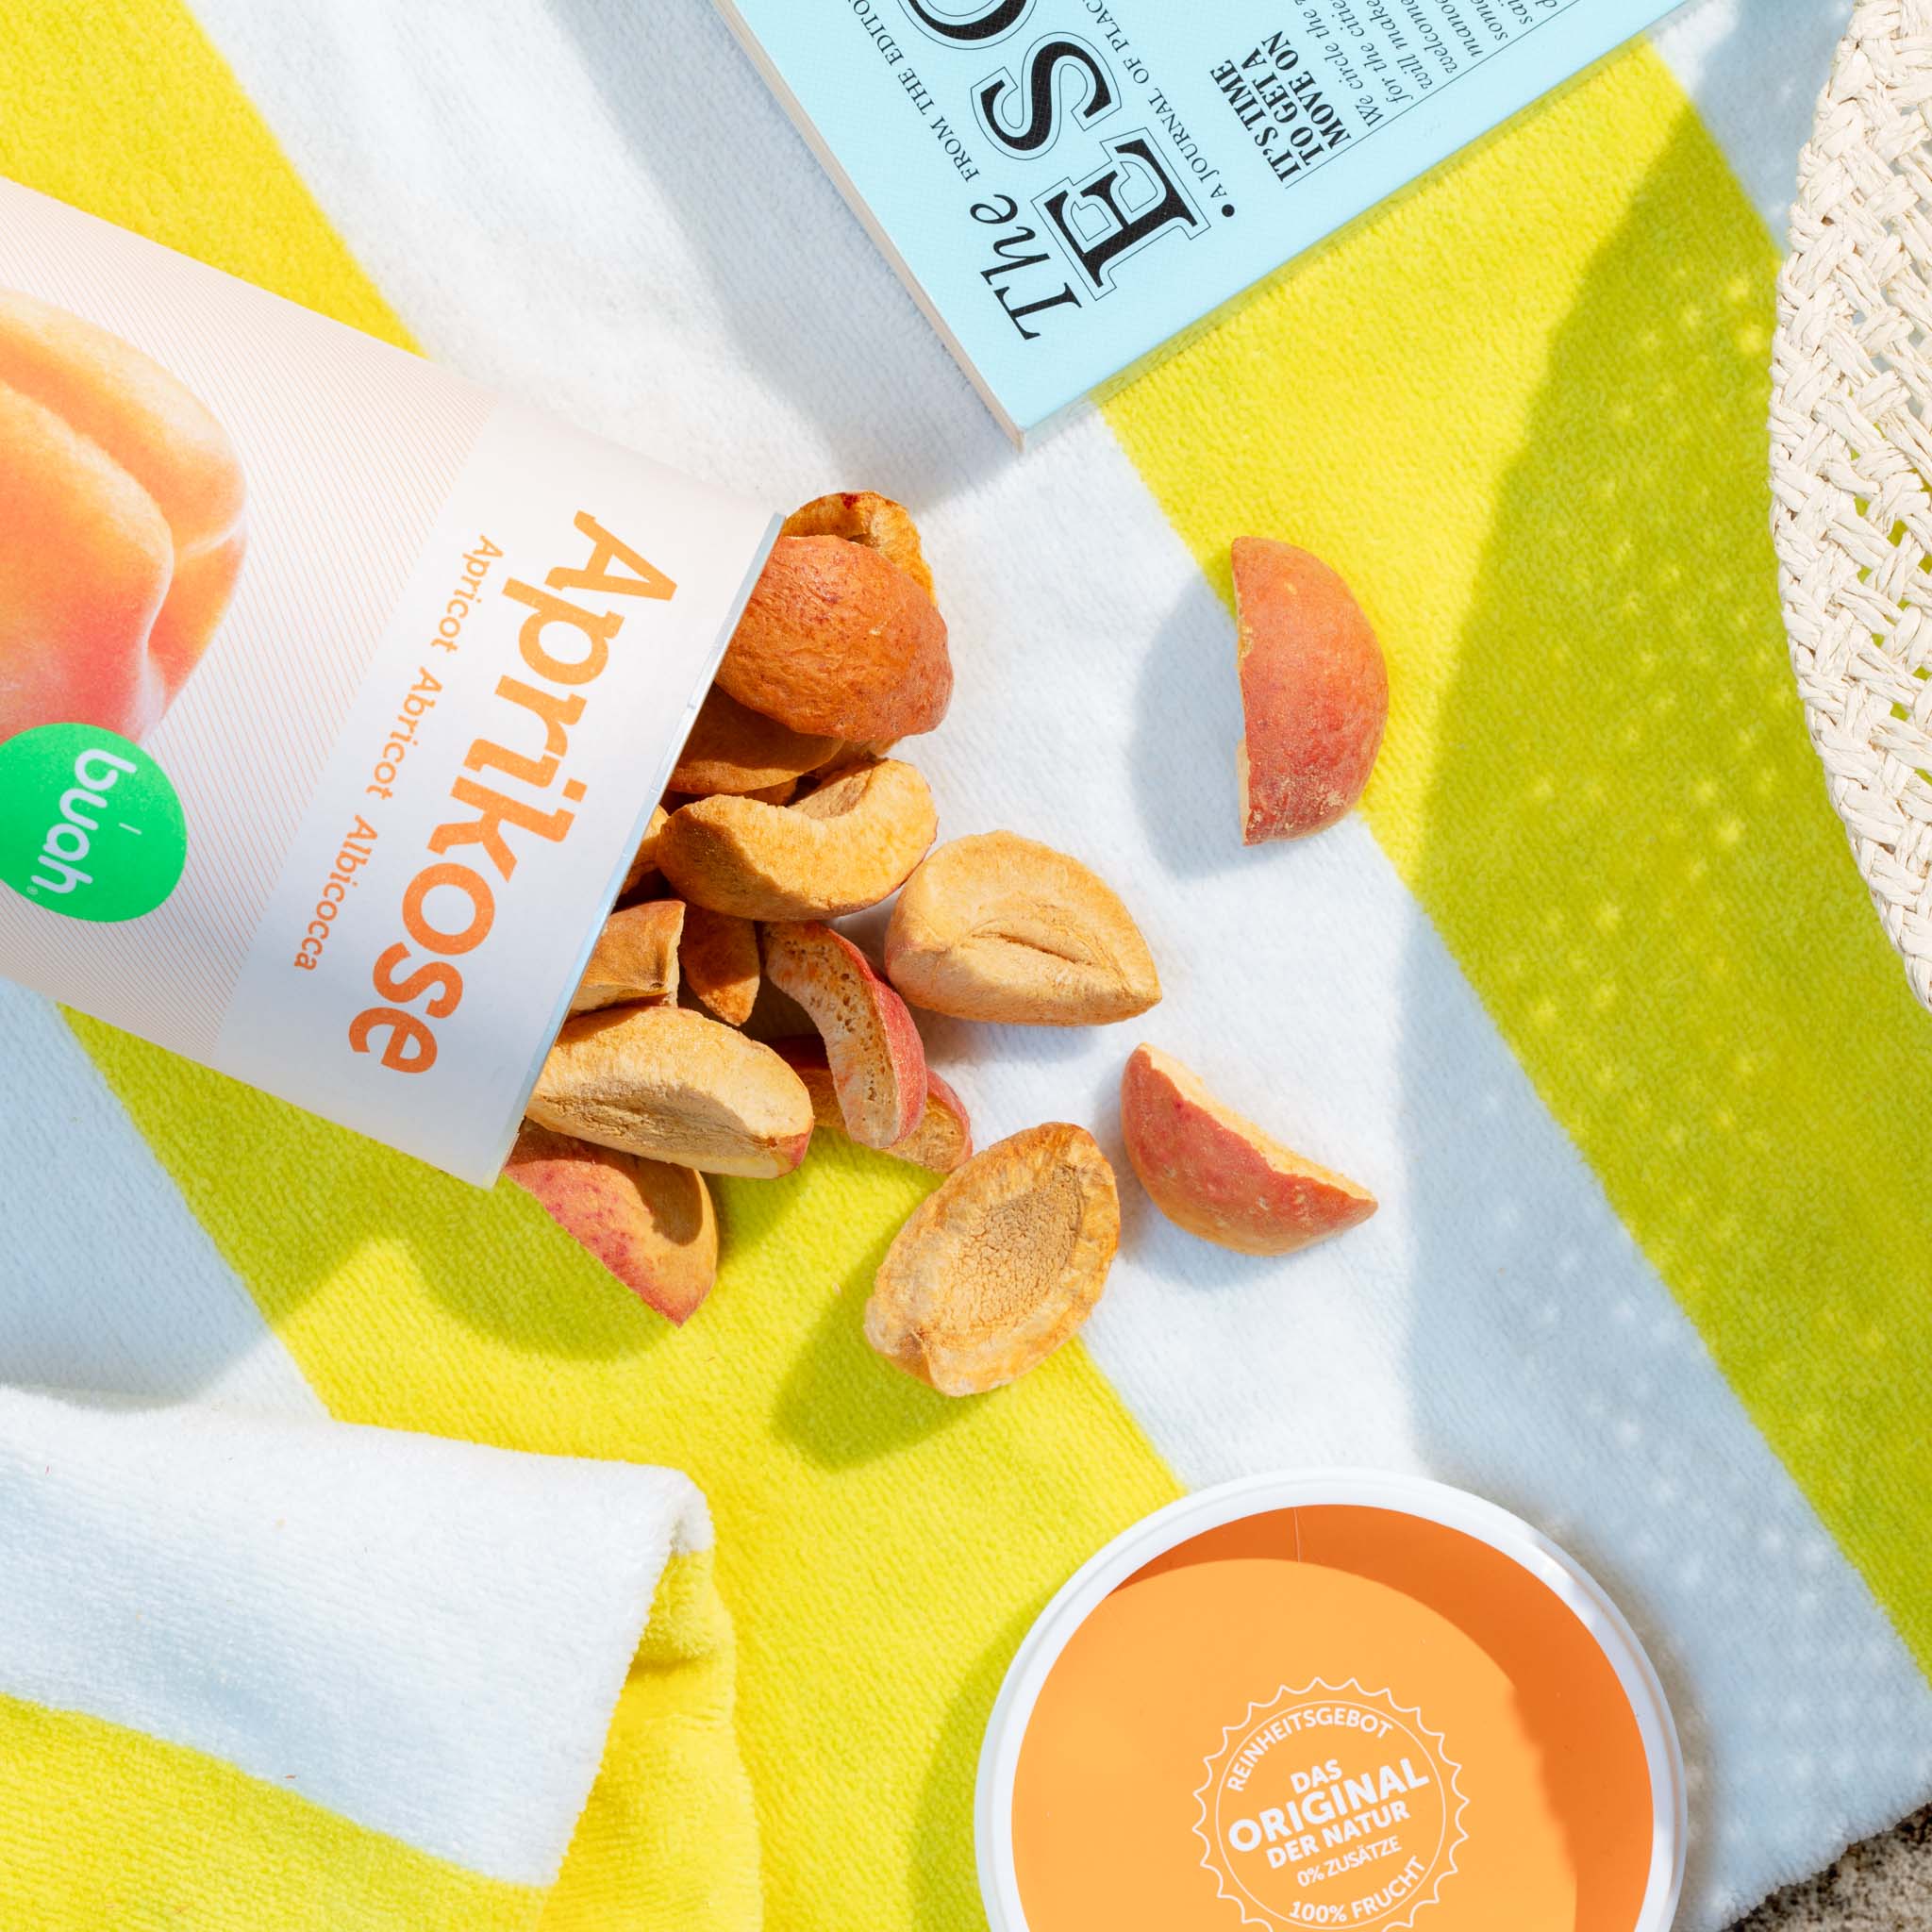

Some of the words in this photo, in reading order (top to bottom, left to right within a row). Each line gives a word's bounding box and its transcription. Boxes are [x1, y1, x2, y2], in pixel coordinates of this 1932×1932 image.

[848, 0, 904, 66] EDITO
[1260, 30, 1299, 71] ON
[1303, 8, 1330, 40] the
[1434, 0, 1485, 58] mano
[1123, 57, 1150, 85] OF
[1241, 47, 1268, 71] A
[1324, 42, 1364, 90] circle
[1360, 42, 1388, 74] the
[1396, 53, 1434, 90] will
[898, 67, 935, 115] THE
[1209, 58, 1267, 132] TIME
[1252, 71, 1299, 124] GET
[1288, 70, 1352, 150] MOVE
[1355, 94, 1384, 127] We
[1381, 77, 1414, 104] for
[929, 115, 981, 183] FROM
[1147, 87, 1220, 183] JOURNAL
[1290, 125, 1325, 167] TO
[1210, 183, 1227, 198] A
[970, 193, 1083, 341] The
[429, 534, 505, 654] Apricot
[366, 666, 444, 801] Abricot
[346, 508, 679, 1075] Aprikose
[293, 814, 379, 972] Albicocca
[1226, 1706, 1393, 1793] REINHEITSGEBOT
[1290, 1757, 1343, 1795] DAS
[1227, 1757, 1431, 1854] ORIGINAL
[1266, 1838, 1321, 1871] DER
[1323, 1799, 1412, 1850] NATUR
[1296, 1864, 1325, 1888] 0%
[1324, 1834, 1403, 1878] ZUSÄTZE
[1289, 1899, 1348, 1924] 100%
[1350, 1855, 1427, 1920] FRUCHT
